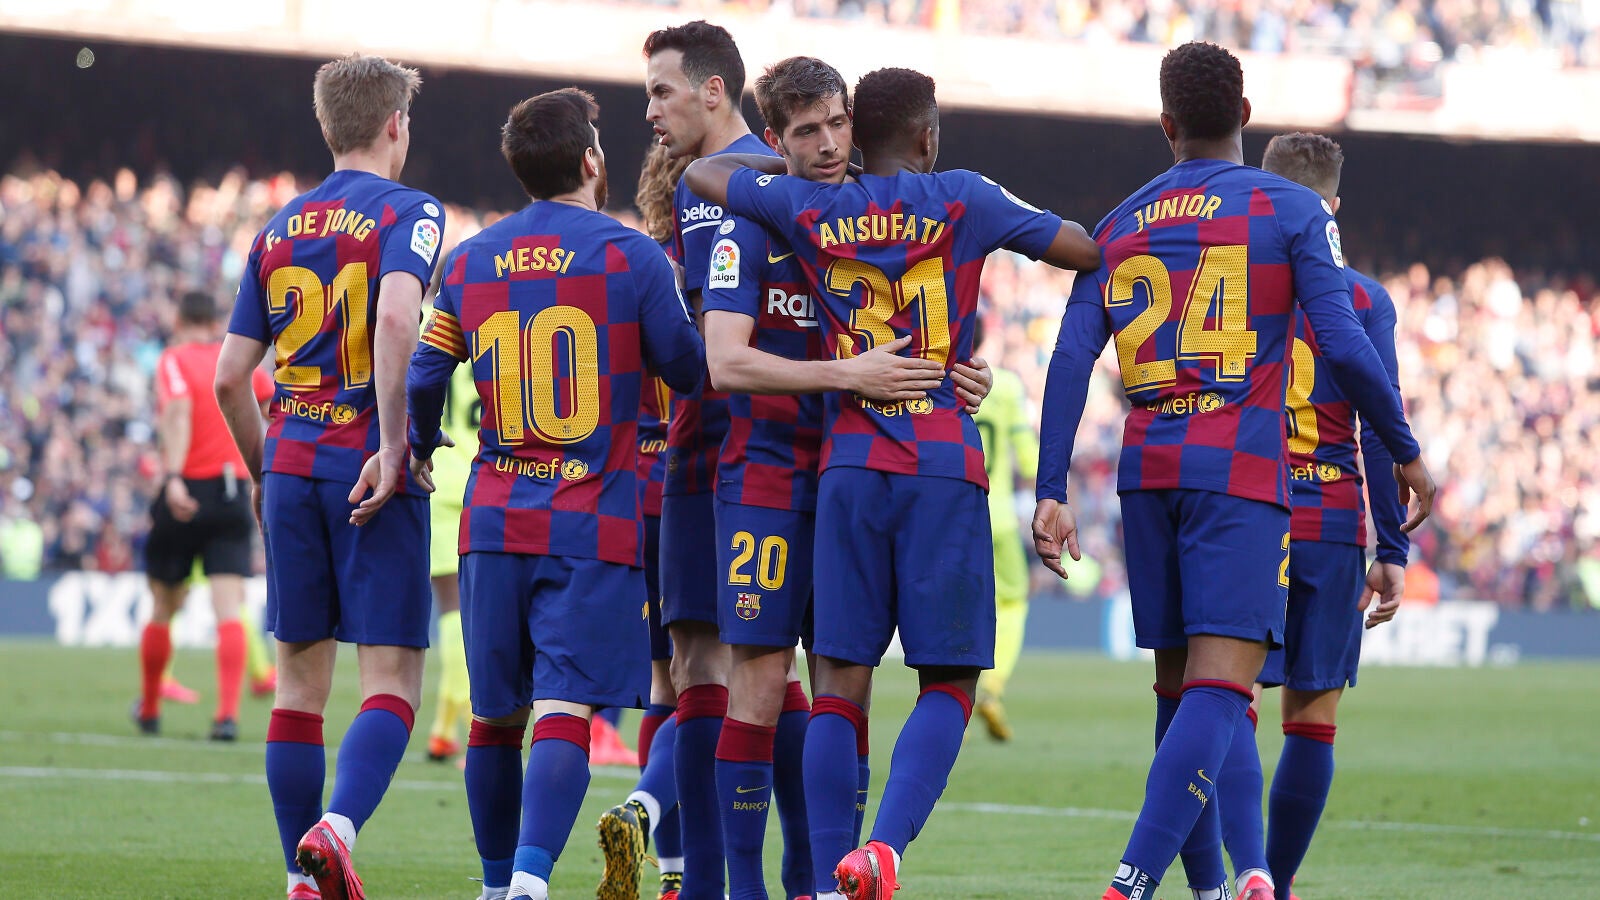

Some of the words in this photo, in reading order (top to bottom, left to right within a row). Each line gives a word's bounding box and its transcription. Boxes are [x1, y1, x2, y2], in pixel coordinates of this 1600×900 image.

[287, 211, 318, 238] DE
[320, 208, 376, 242] JONG
[1134, 194, 1222, 234] JUNIOR
[494, 246, 575, 278] MESSI
[267, 261, 371, 391] 21
[824, 256, 951, 380] 31
[1105, 245, 1257, 395] 24
[472, 305, 601, 445] 10
[280, 395, 332, 422] unicef
[495, 455, 560, 480] unicef
[727, 531, 788, 591] 20
